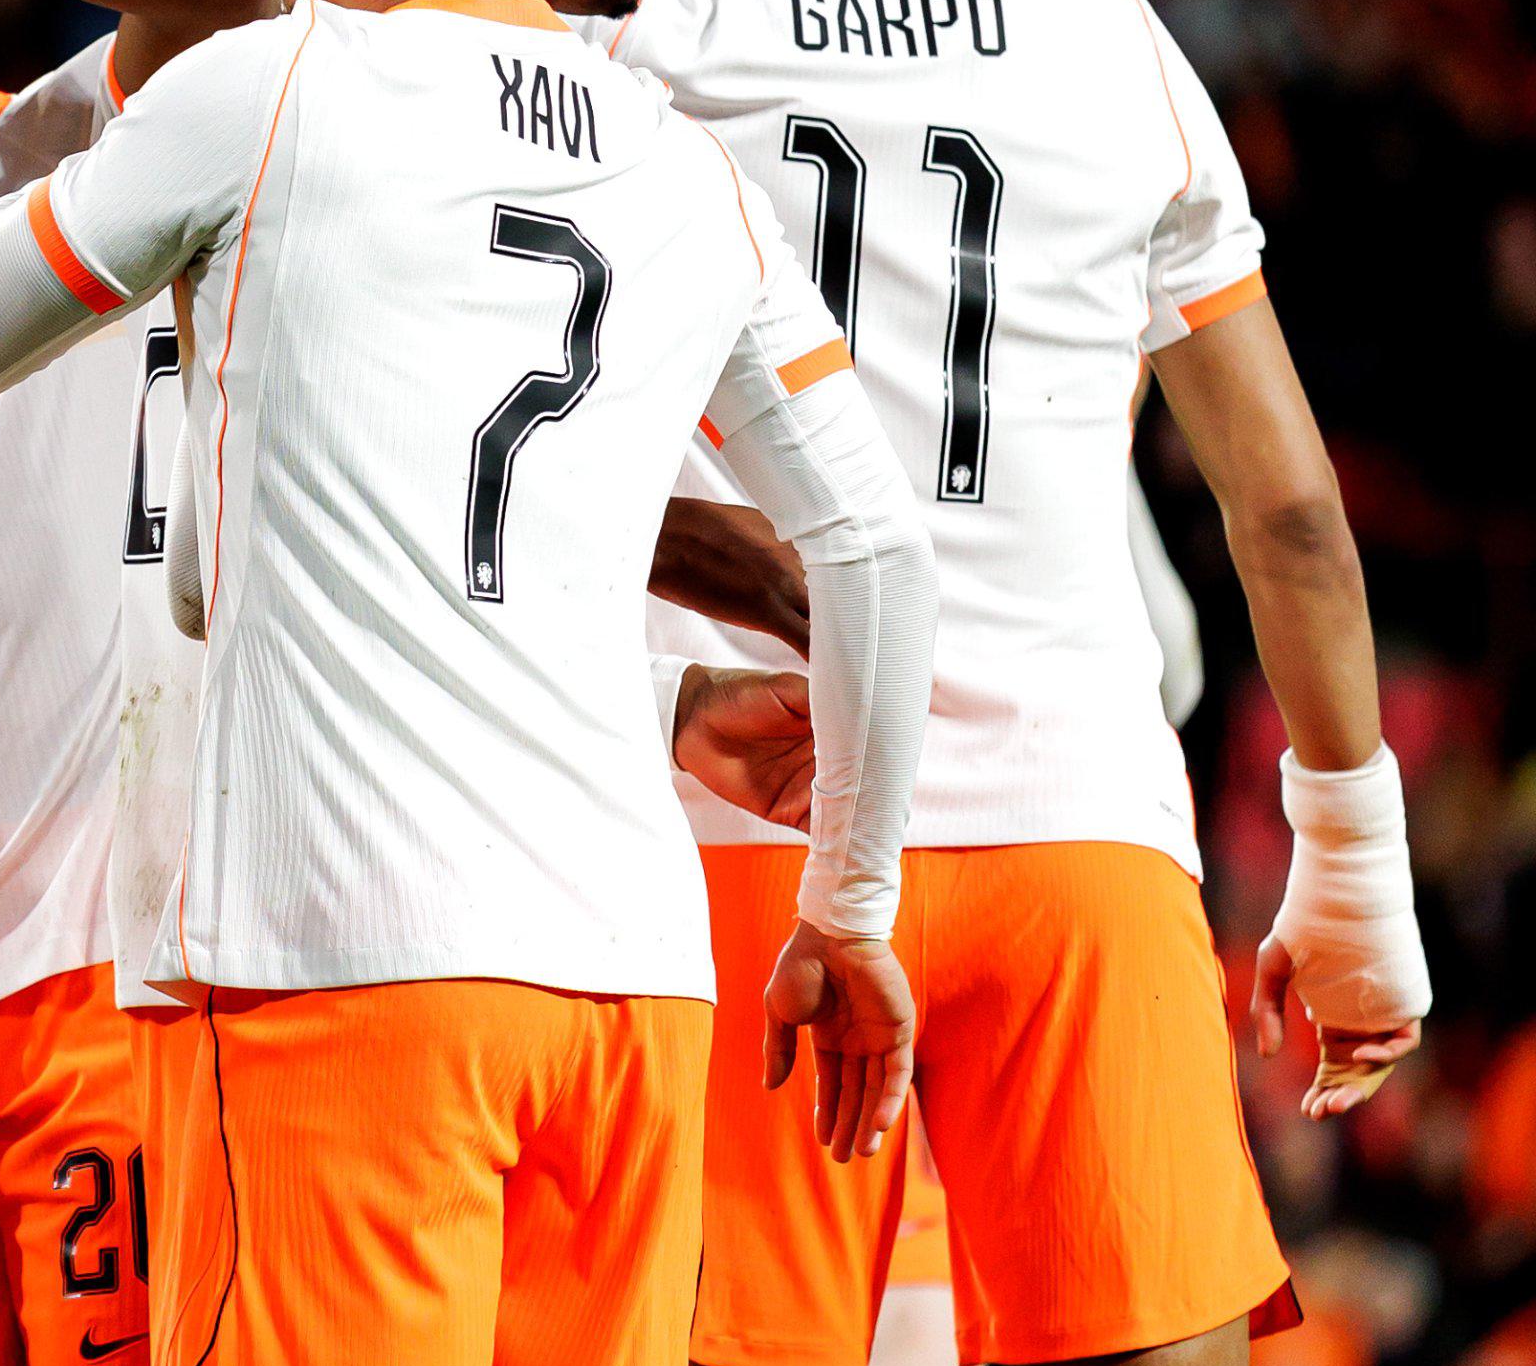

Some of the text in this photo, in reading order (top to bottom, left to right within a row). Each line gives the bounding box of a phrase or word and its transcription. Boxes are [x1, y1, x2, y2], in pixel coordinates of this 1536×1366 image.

[490, 54, 602, 164] XAVI
[465, 203, 612, 605] 7
[782, 114, 1005, 504] 11
